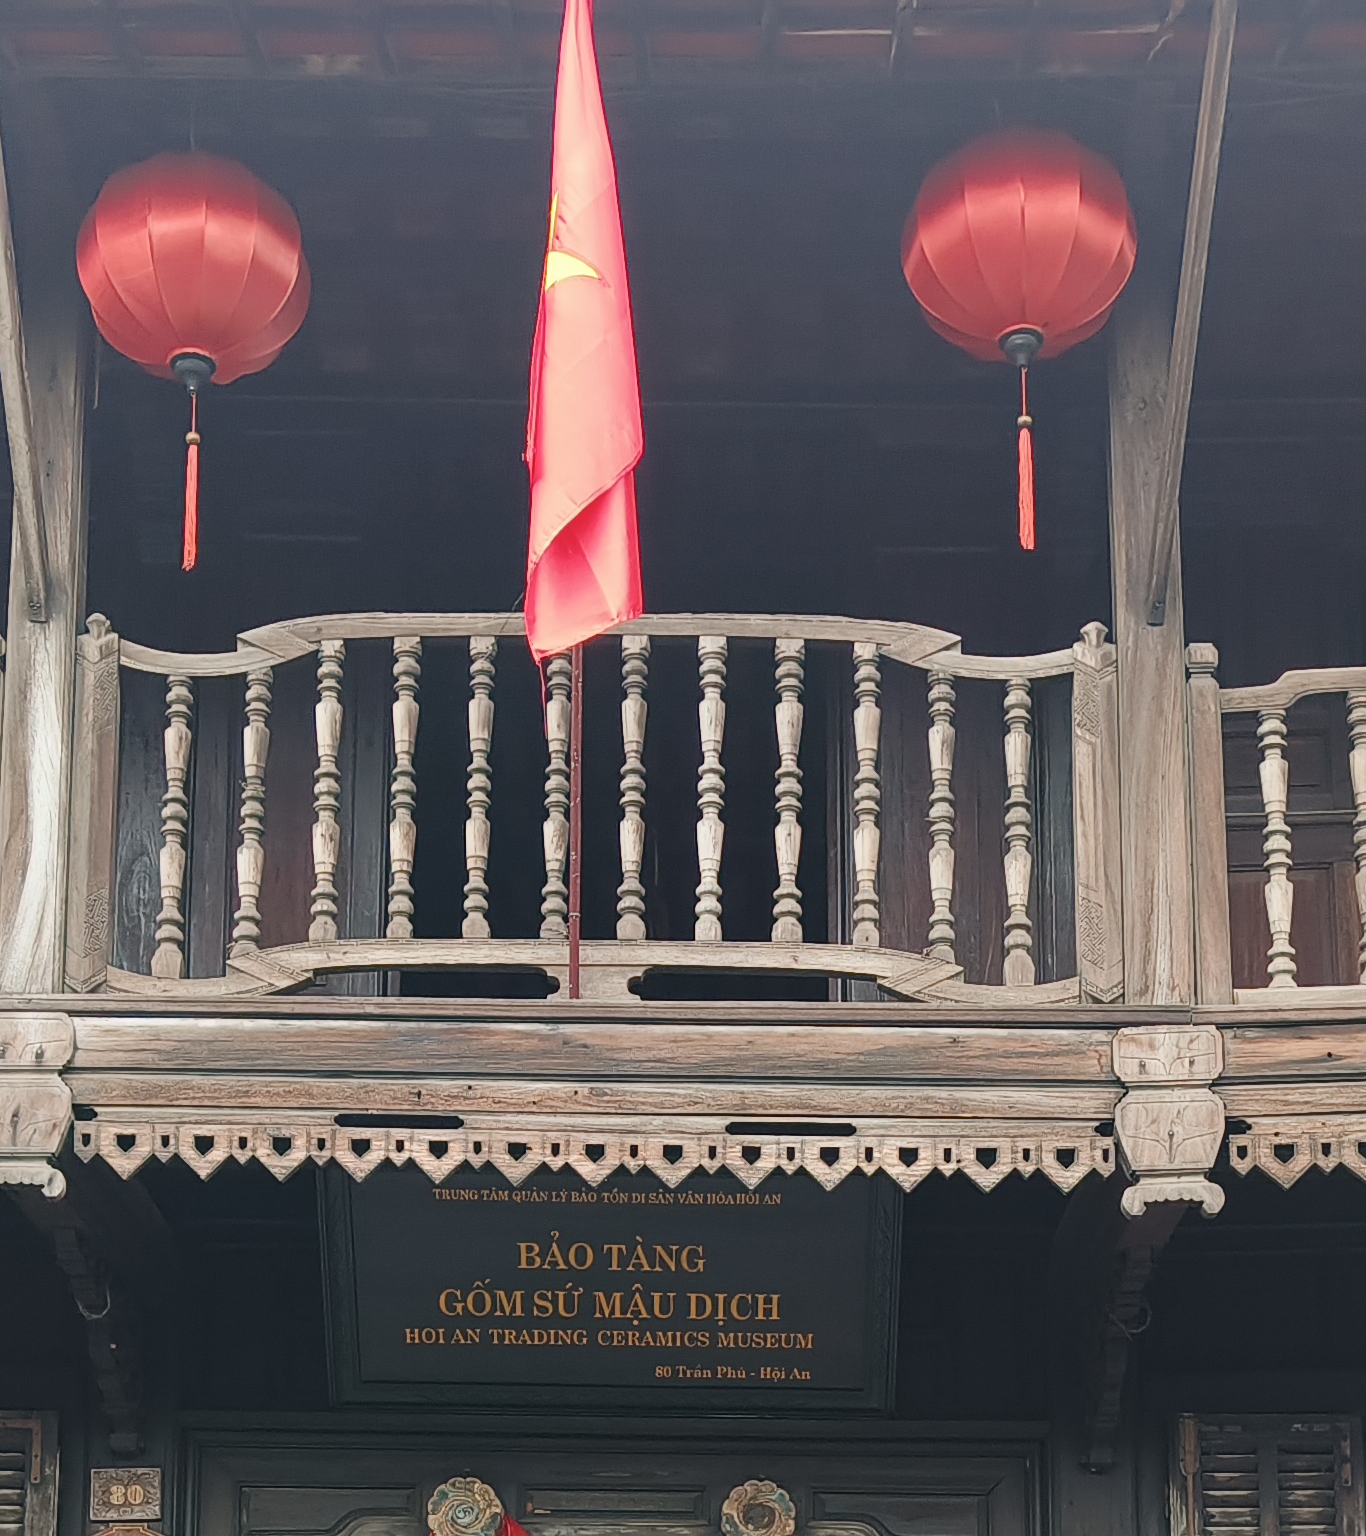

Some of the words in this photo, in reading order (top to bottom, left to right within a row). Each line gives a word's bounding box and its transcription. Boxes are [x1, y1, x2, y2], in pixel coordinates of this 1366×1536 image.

[432, 1188, 478, 1200] TRUNG
[481, 1187, 509, 1201] TÂM
[632, 1192, 646, 1204] DI
[762, 1193, 782, 1205] AN
[516, 1230, 594, 1271] BẢO
[603, 1235, 706, 1273] TÀNG
[438, 1278, 526, 1317] GỐM
[533, 1282, 584, 1318] SỨ
[592, 1283, 677, 1326] MẬU
[686, 1293, 781, 1326] DỊCH
[404, 1327, 445, 1344] HOI
[450, 1328, 481, 1345] AN
[488, 1329, 589, 1346] TRADING
[597, 1330, 710, 1347] CERAMICS
[717, 1332, 814, 1349] MUSEUM
[655, 1366, 672, 1378] 80
[760, 1366, 785, 1382] Hội
[789, 1367, 811, 1380] An
[109, 1484, 144, 1505] 80
